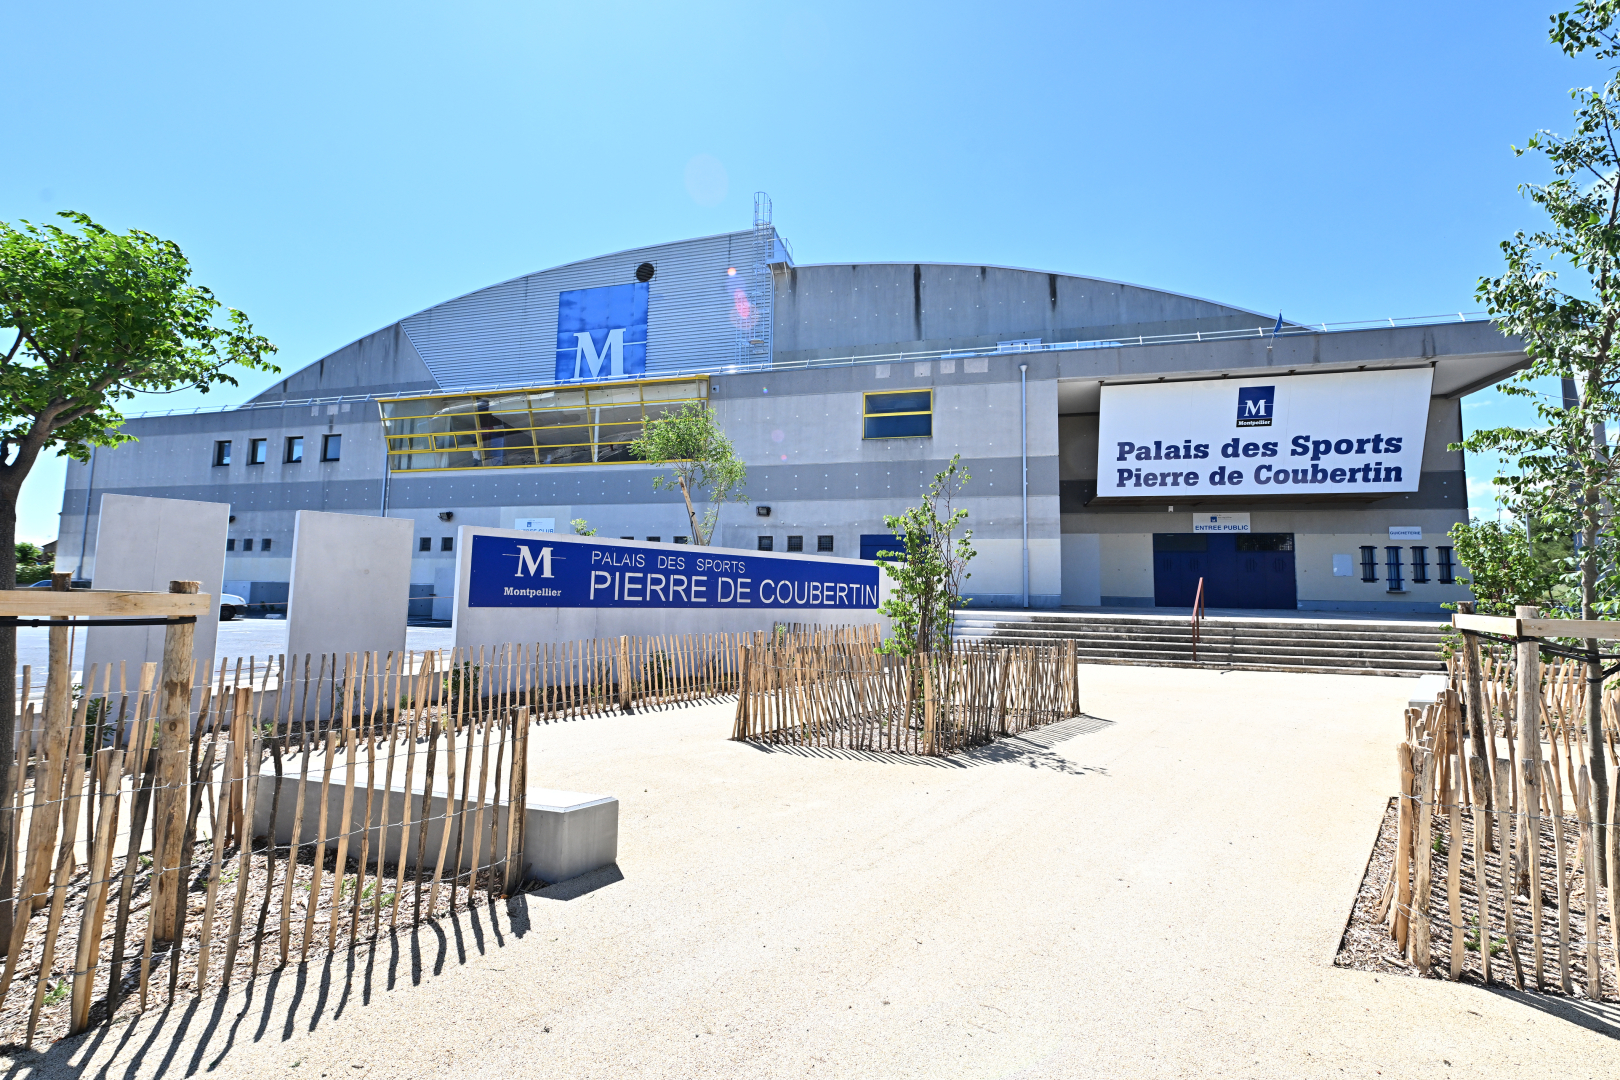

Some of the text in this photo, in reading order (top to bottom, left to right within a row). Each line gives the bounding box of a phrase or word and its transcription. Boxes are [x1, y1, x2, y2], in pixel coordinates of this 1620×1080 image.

[570, 328, 628, 382] M
[1243, 399, 1267, 417] M
[1116, 433, 1402, 461] Palais des Sports
[1116, 462, 1402, 487] Pierre de Coubertin
[514, 544, 555, 578] M
[591, 550, 746, 574] PALAIS DES SPORTS
[503, 586, 562, 598] Montpellier
[589, 570, 877, 606] PIERRE DE COUBERTIN
